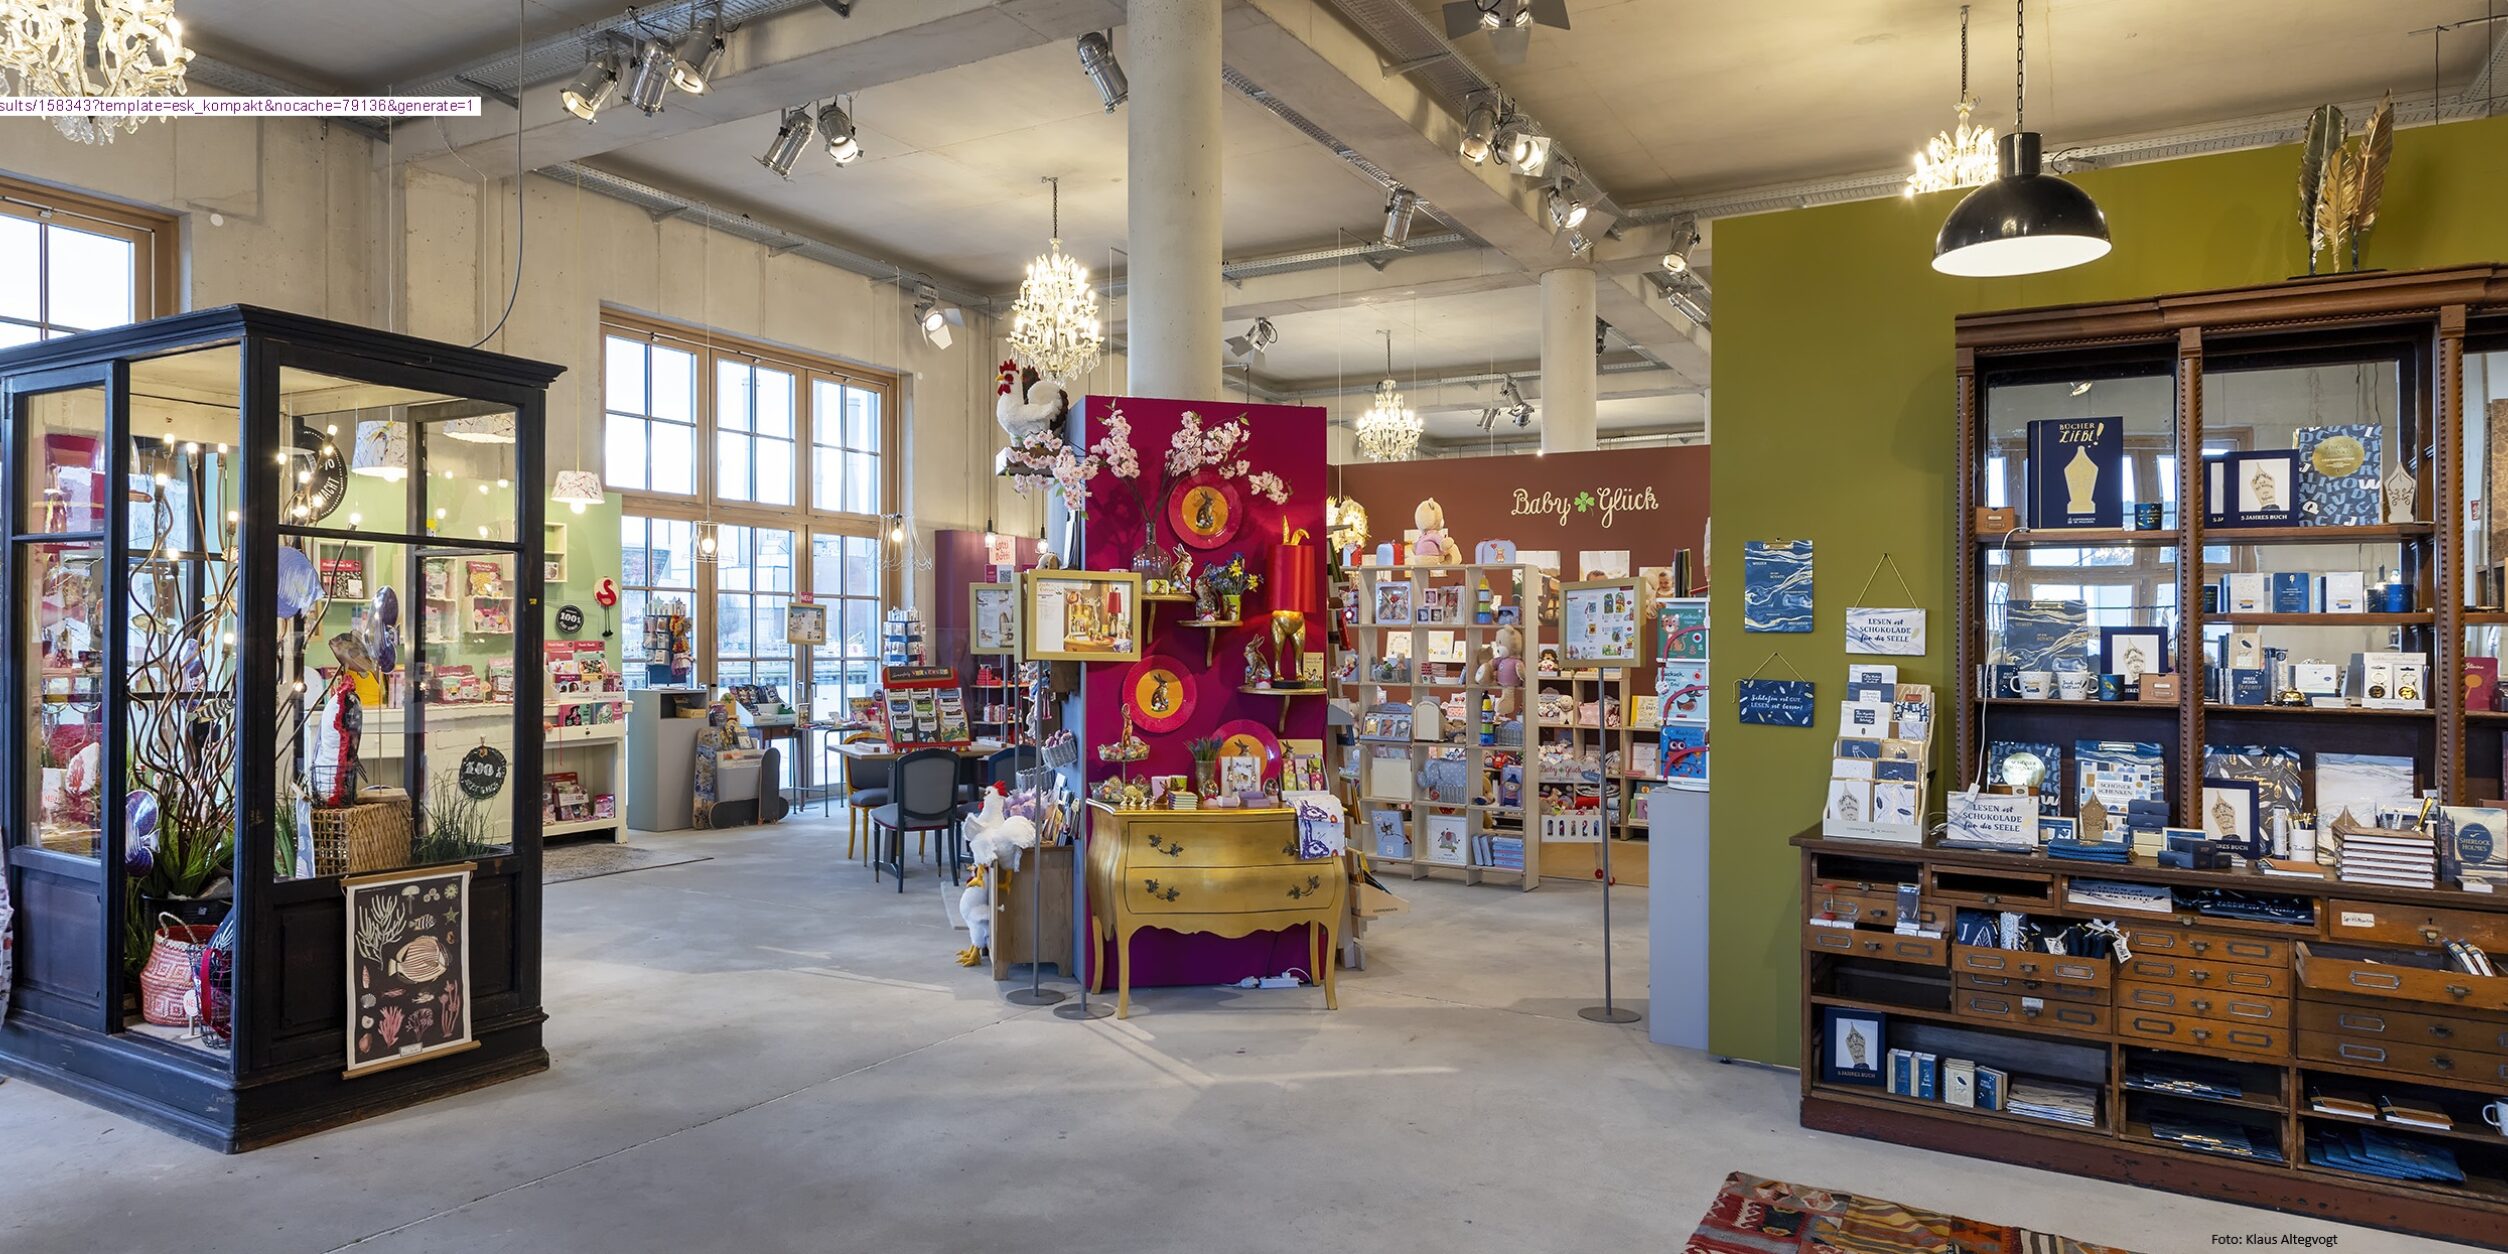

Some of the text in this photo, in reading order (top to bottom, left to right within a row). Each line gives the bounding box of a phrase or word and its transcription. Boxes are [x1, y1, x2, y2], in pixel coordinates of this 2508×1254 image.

[2059, 422, 2095, 430] BÜCHER
[1511, 486, 1659, 529] Baby Glück
[1860, 626, 1911, 634] SCHOKOLADE
[1860, 633, 1872, 643] für
[1887, 635, 1910, 643] SEELE
[1972, 804, 2000, 812] LESEN
[1962, 812, 2023, 823] SCHOKOLADE
[1963, 821, 2020, 832] für die SEELE
[2460, 837, 2490, 846] SHERLOCK
[2462, 844, 2488, 852] HOLMES
